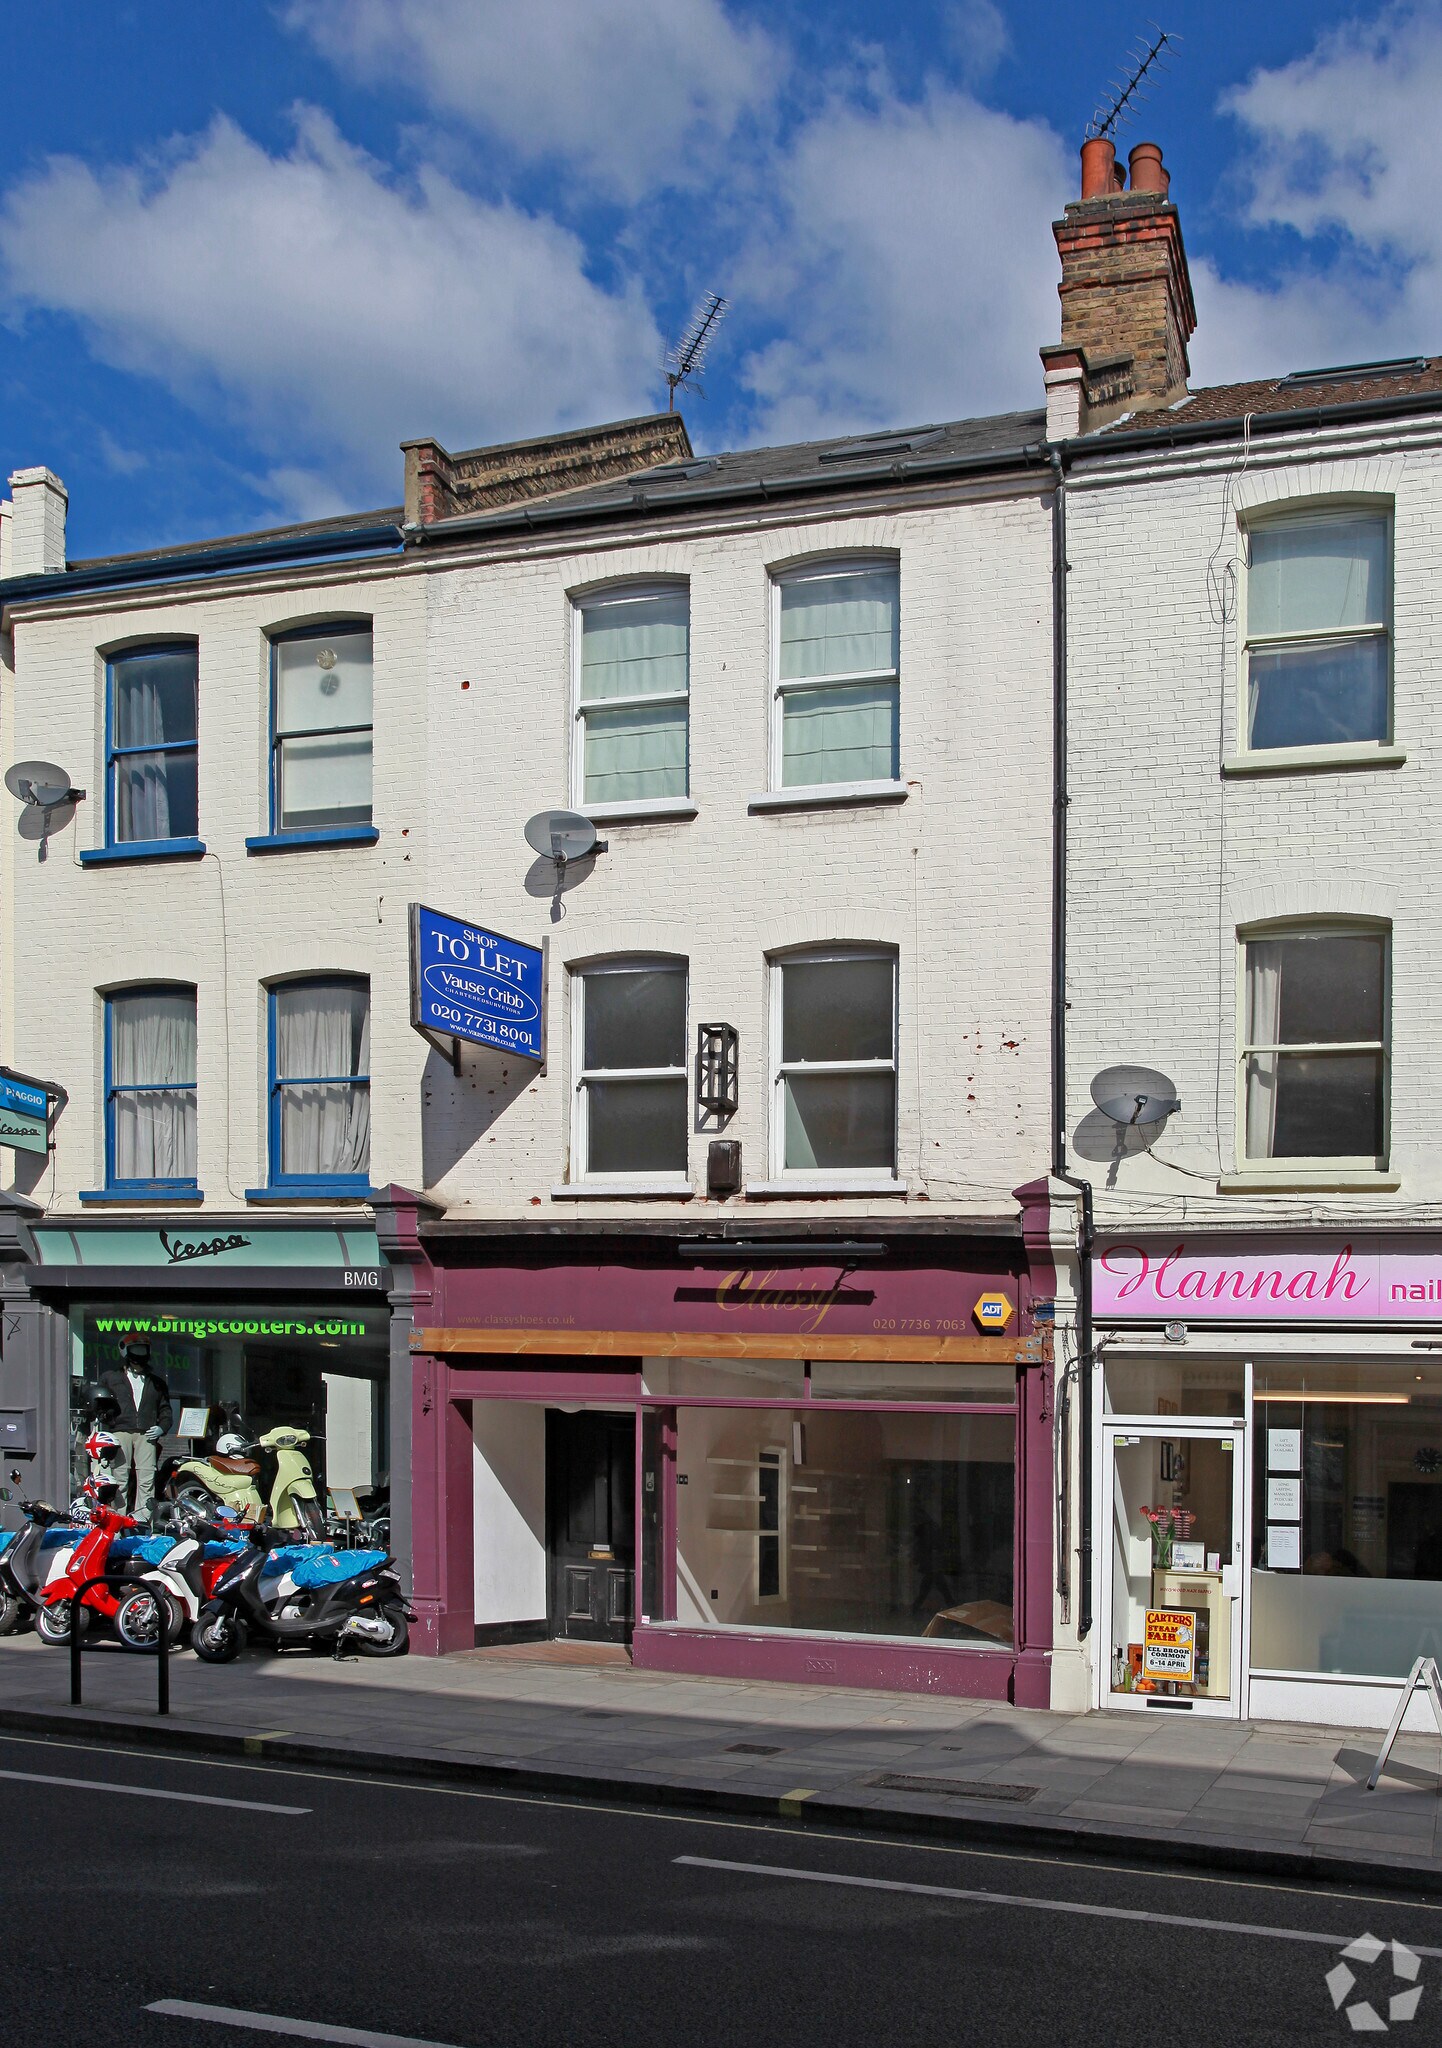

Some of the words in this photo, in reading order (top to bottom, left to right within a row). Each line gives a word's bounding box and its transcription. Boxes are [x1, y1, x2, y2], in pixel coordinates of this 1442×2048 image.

[463, 929, 498, 949] SHOP
[431, 930, 470, 961] TO
[479, 947, 528, 981] LET
[441, 970, 486, 996] Vause
[488, 986, 524, 1009] Cribb
[431, 1003, 461, 1022] 020
[464, 1013, 496, 1033] 7731
[500, 1024, 533, 1046] 8001
[6, 1087, 43, 1105] PIAGGIO
[159, 1228, 252, 1264] Vespa
[344, 1271, 378, 1286] BMG
[1098, 1243, 1371, 1302] Hannah
[716, 1266, 842, 1334] Classy
[982, 1305, 1002, 1315] ADT
[457, 1314, 576, 1325] www.classyshoes.co.uk
[873, 1319, 896, 1329] 020
[900, 1319, 931, 1330] 7736
[936, 1319, 966, 1331] 7063
[96, 1317, 366, 1339] www.bmgscooters.com
[1147, 1612, 1192, 1627] CARTERS
[1147, 1625, 1178, 1633] STEAM
[1147, 1632, 1176, 1642] FAIR
[1163, 1647, 1190, 1655] BROOK
[1167, 1660, 1187, 1668] APRIL
